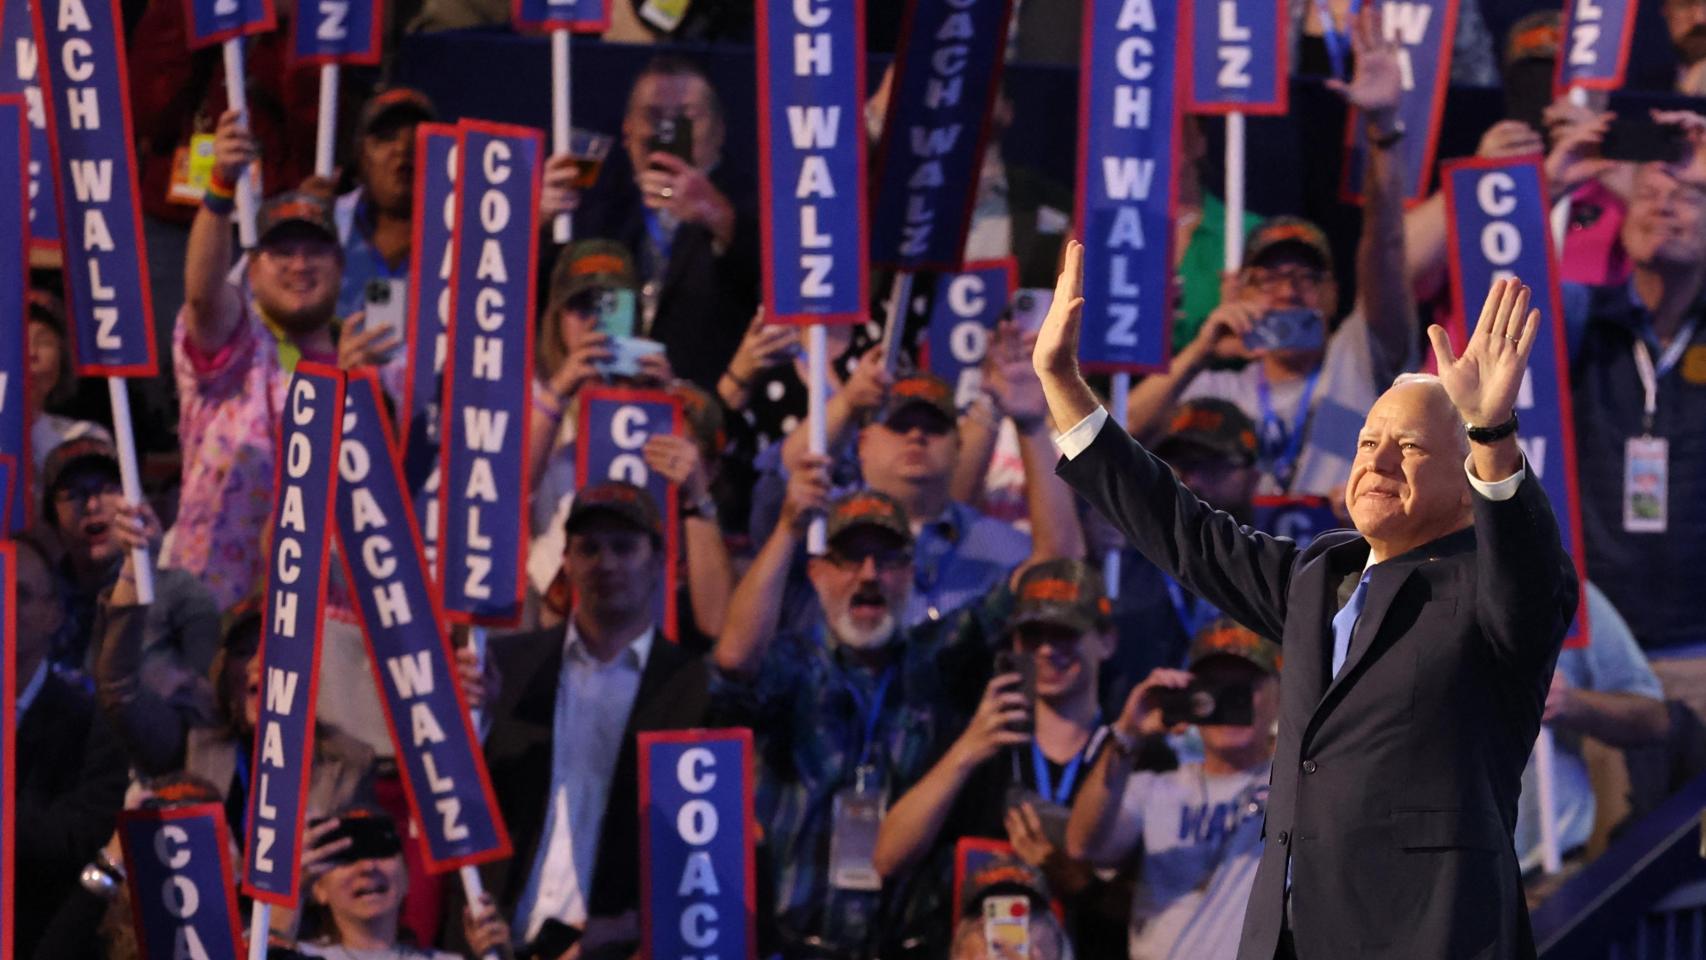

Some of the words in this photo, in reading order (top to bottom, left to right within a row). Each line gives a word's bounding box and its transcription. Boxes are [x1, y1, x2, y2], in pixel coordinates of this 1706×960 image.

[924, 0, 977, 110] ACH
[70, 159, 122, 349] WALZ
[473, 139, 512, 381] COACH
[787, 106, 840, 298] WALZ
[898, 123, 963, 257] WALZ
[1101, 156, 1155, 346] WALZ
[273, 378, 317, 638] COACH
[463, 406, 509, 600] WALZ
[255, 666, 299, 873] WALZ
[387, 650, 469, 842] WALZ
[676, 747, 721, 960] COAC
